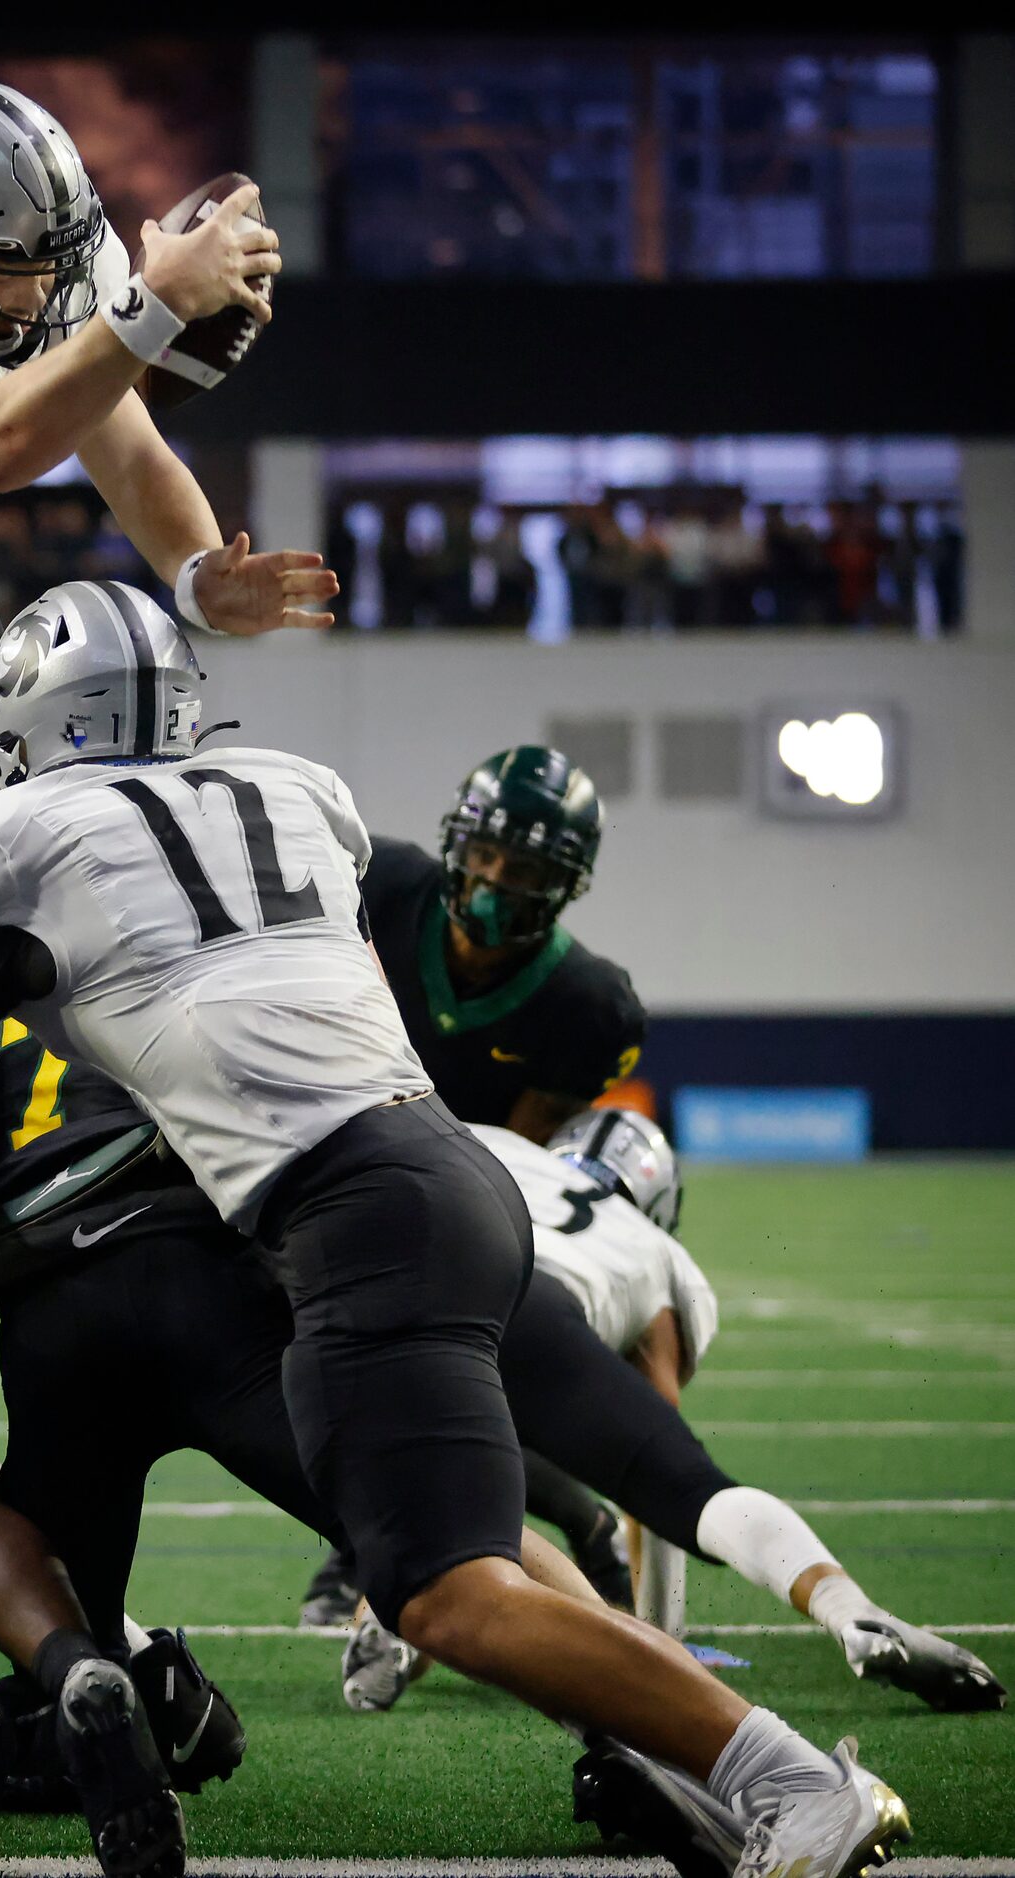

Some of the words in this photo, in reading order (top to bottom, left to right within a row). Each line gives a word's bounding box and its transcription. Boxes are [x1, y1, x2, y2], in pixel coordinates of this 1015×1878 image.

[49, 223, 86, 248] WILDCATS
[111, 712, 120, 745] 1
[166, 708, 180, 742] 2
[105, 768, 326, 944] 12
